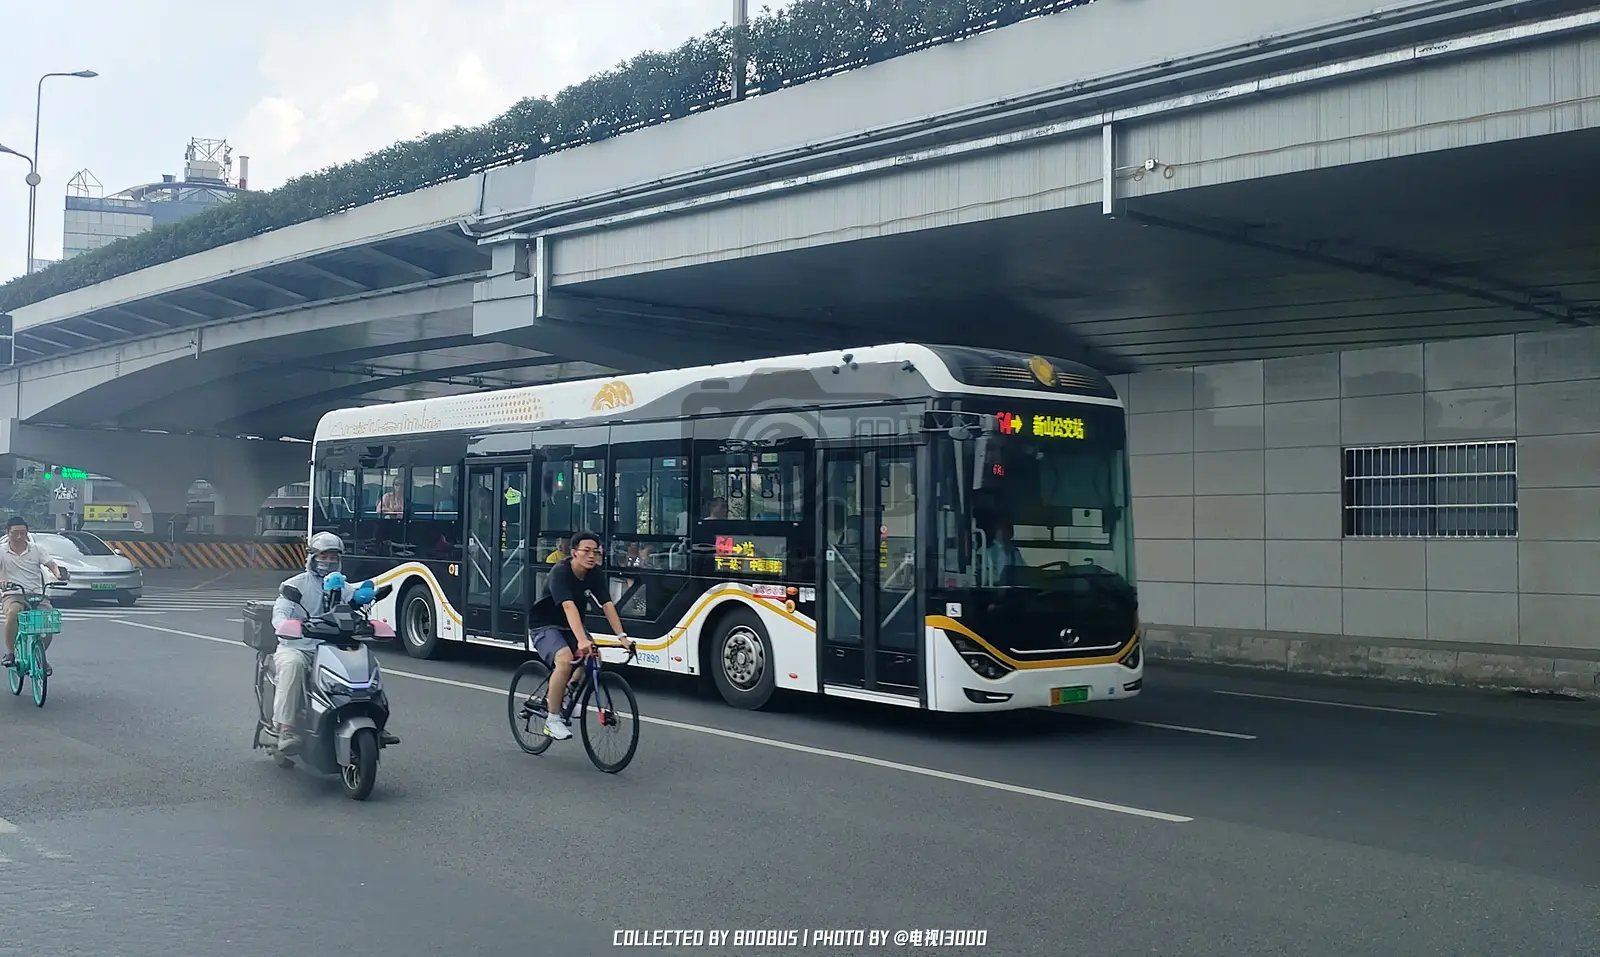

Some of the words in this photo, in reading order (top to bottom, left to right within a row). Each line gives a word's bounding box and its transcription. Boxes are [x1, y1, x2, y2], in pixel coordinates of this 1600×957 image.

[1033, 415, 1085, 439] 新山公交站
[715, 536, 733, 555] 64
[638, 651, 660, 664] 27890
